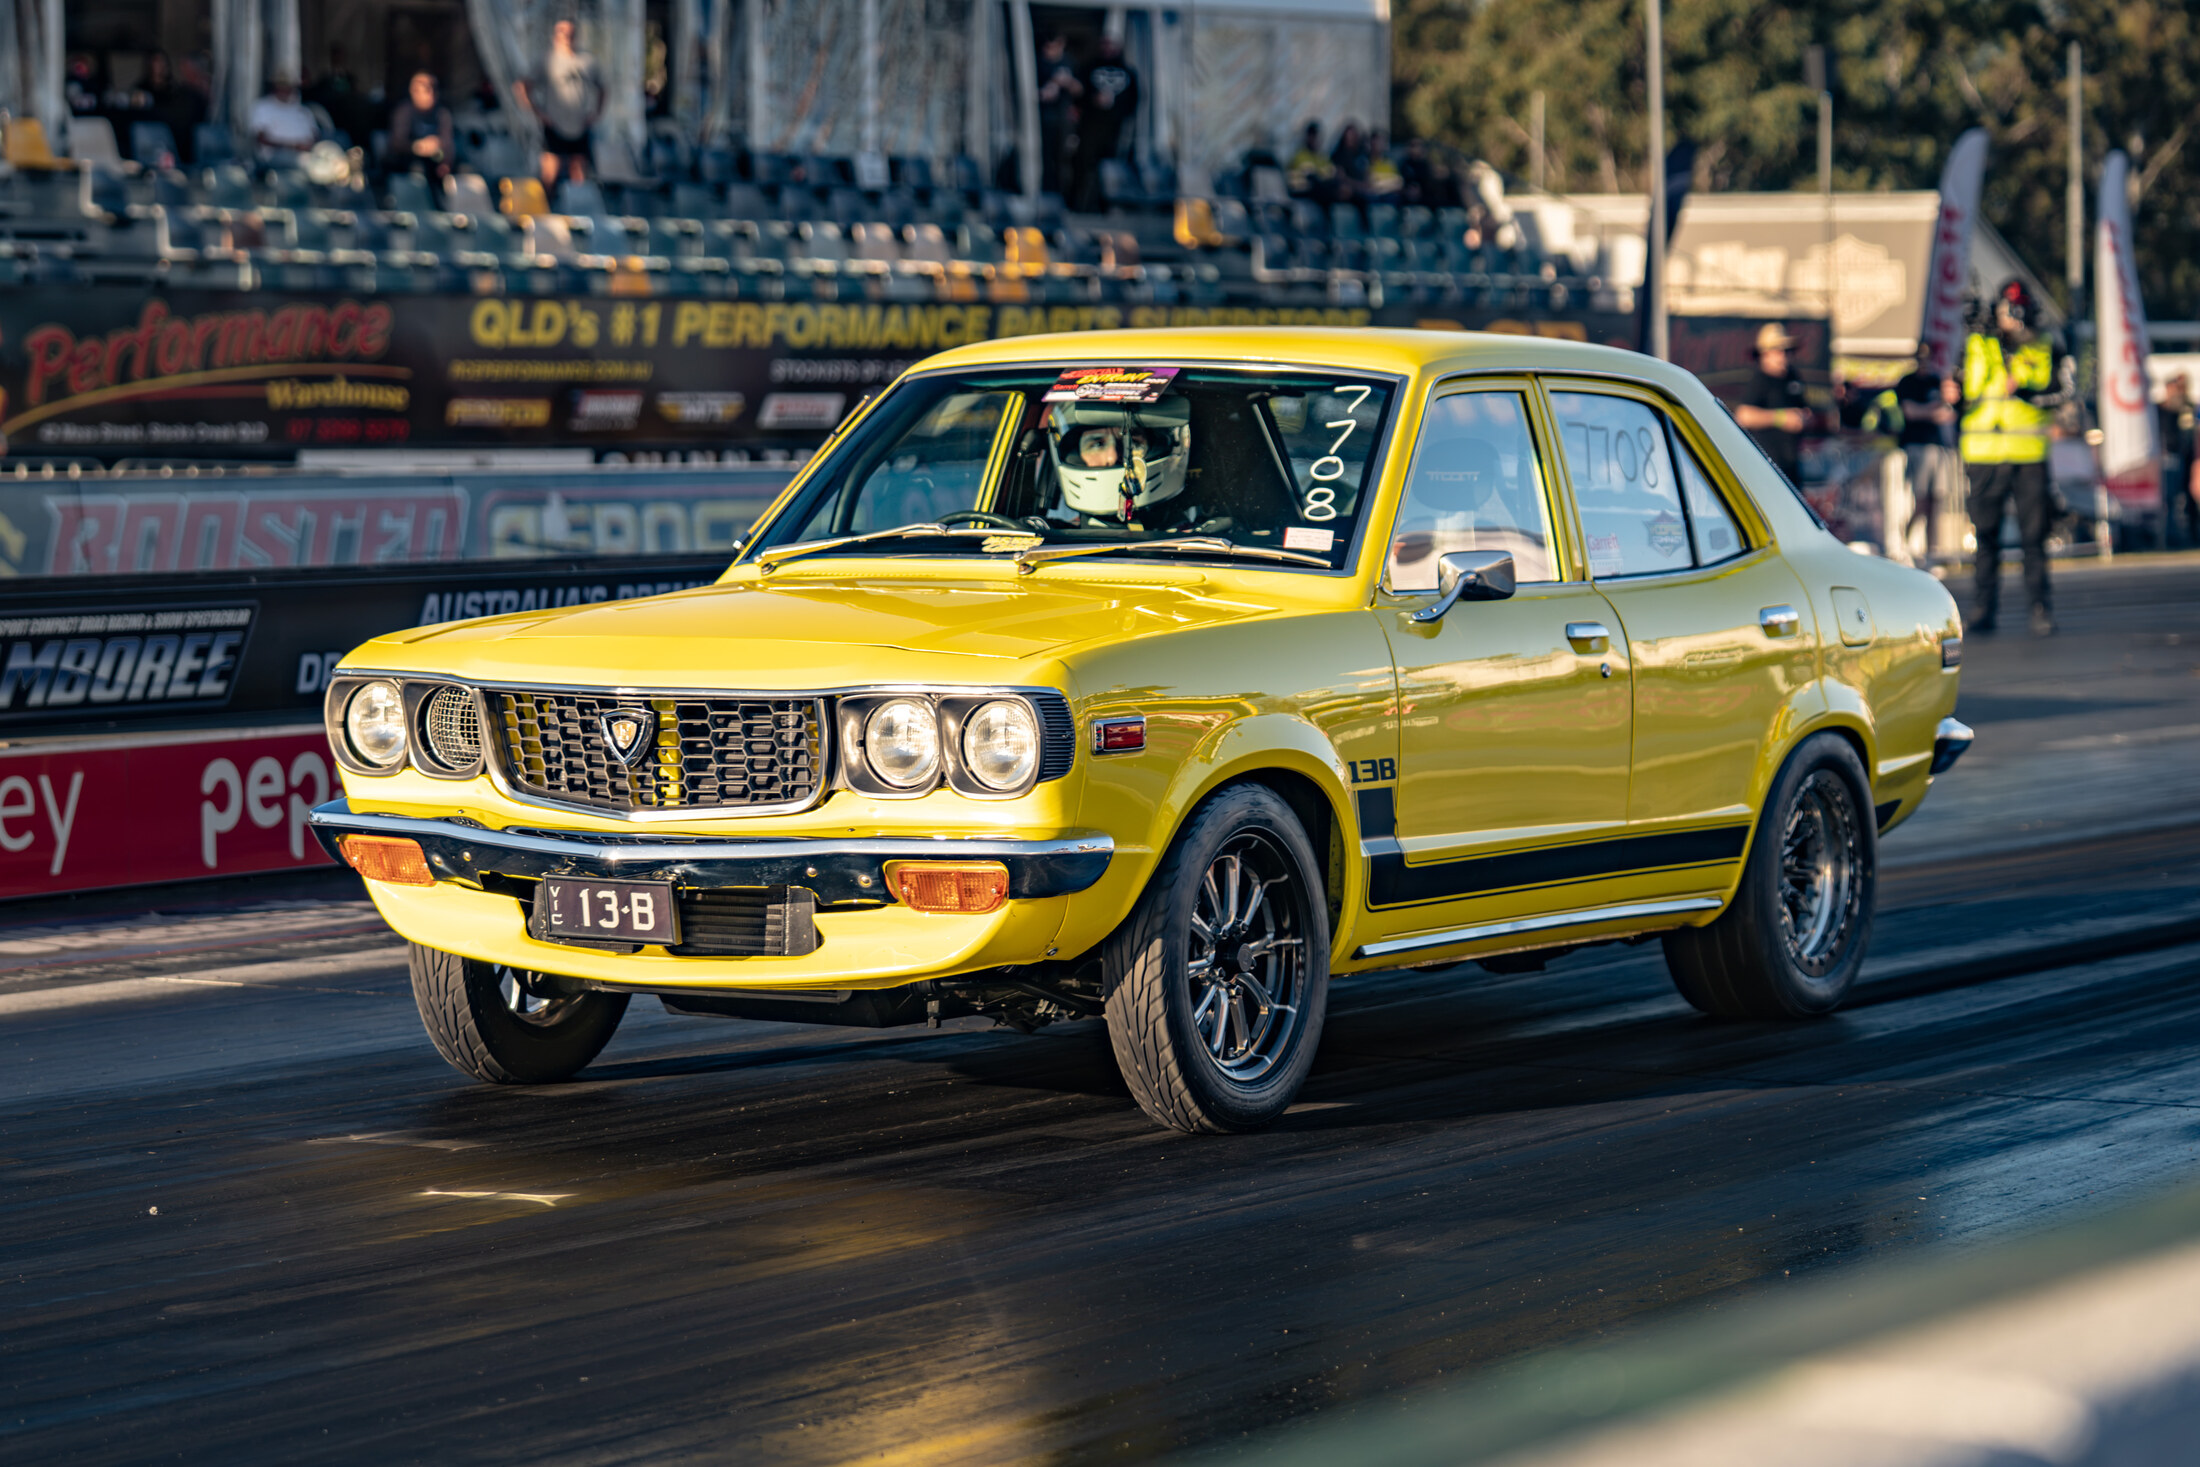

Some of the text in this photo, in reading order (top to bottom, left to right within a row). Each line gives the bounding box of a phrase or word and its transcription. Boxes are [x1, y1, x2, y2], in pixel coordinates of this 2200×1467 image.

[26, 300, 391, 404] Performance
[470, 302, 600, 348] QLD's
[608, 303, 663, 348] #1
[672, 303, 992, 347] PERFORMANCE
[267, 374, 410, 411] Warehouse
[1566, 422, 1658, 488] 7708
[420, 585, 607, 627] AUSTRALIA'S
[0, 632, 243, 708] MBOREE
[1348, 758, 1396, 783] 13B
[201, 751, 346, 868] pep
